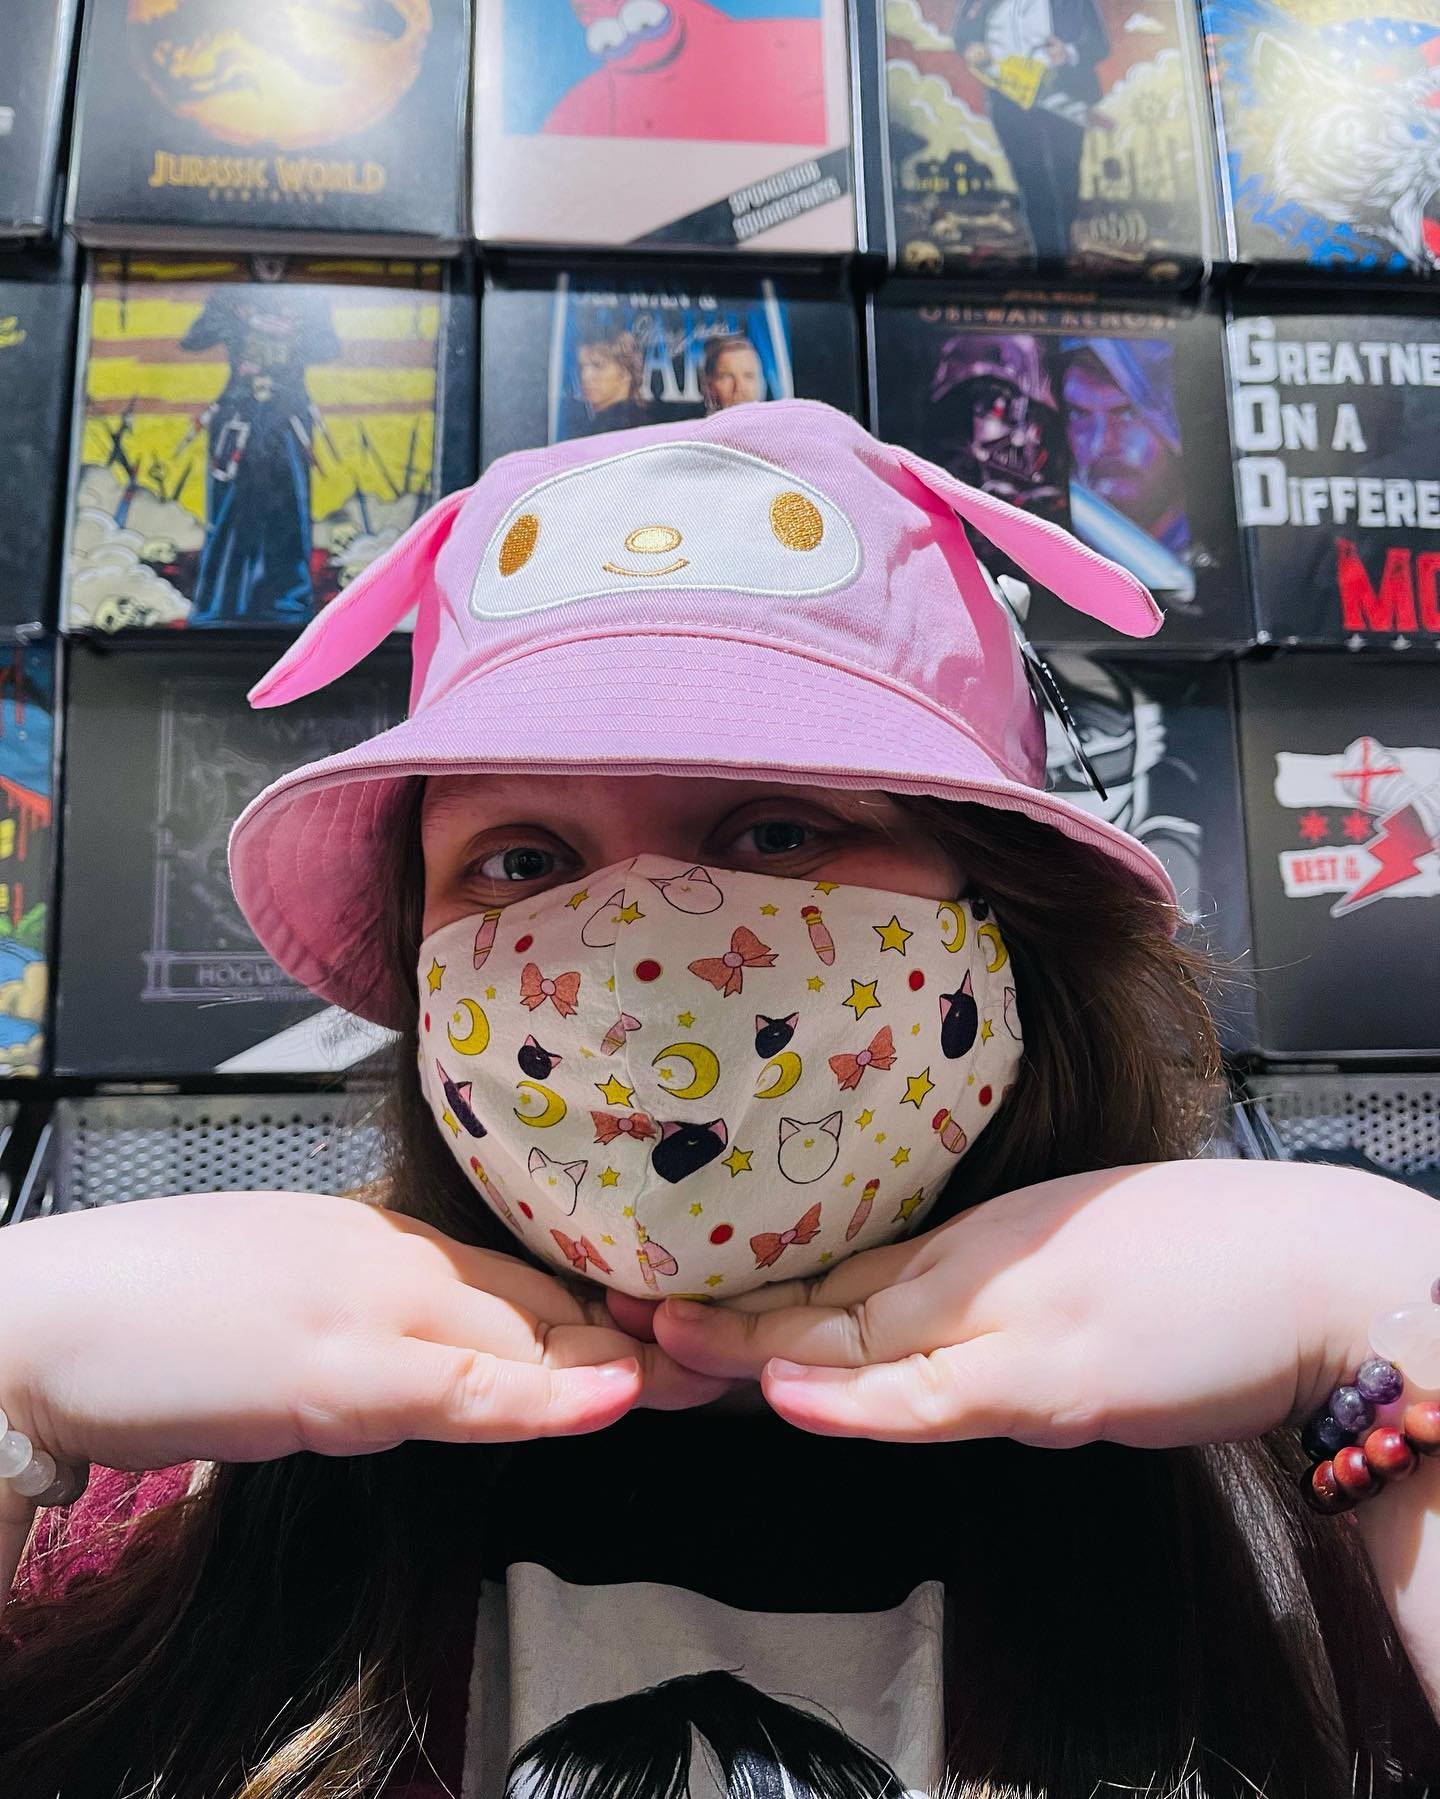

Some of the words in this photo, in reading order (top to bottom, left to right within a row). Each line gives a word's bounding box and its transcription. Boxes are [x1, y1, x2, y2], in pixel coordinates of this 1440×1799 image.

[148, 150, 269, 188] JURASSIC
[274, 155, 386, 194] WORLD
[1232, 316, 1440, 386] GREATNE
[1234, 384, 1318, 451] ON
[1331, 403, 1367, 452] A
[1238, 456, 1440, 529] DIFFERE
